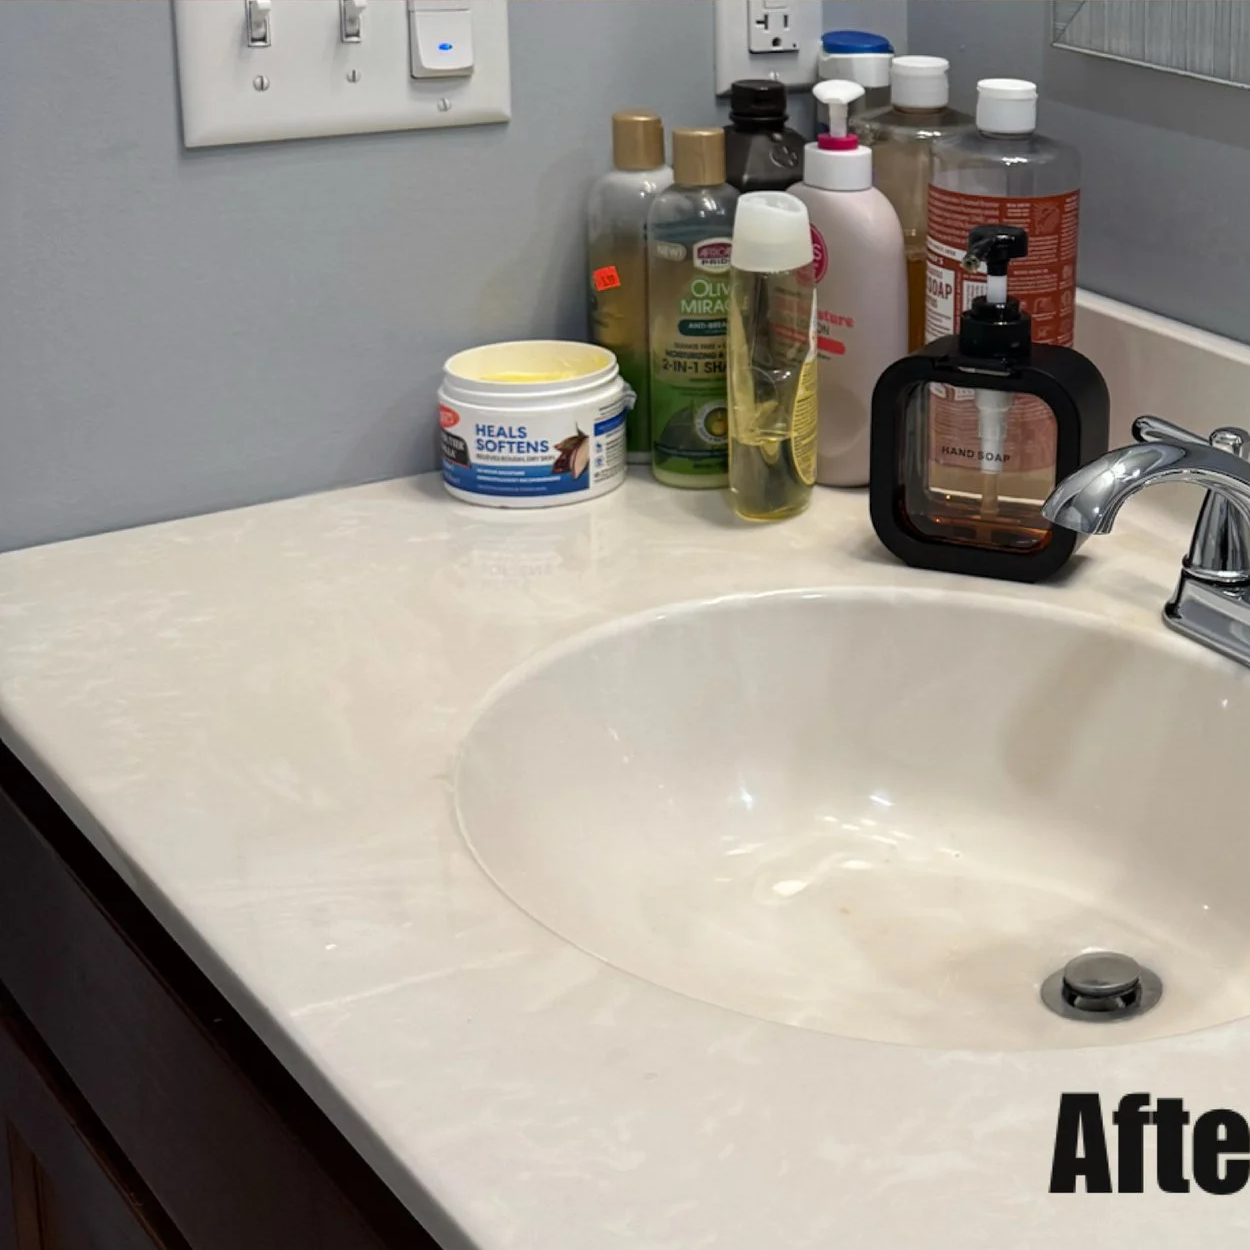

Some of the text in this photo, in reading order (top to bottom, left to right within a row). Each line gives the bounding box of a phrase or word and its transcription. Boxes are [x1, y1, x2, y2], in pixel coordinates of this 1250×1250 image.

[662, 358, 699, 373] 2-IN-1
[476, 423, 527, 439] HEALS
[477, 439, 549, 454] SOFTENS
[942, 446, 1011, 463] HAND SOAP
